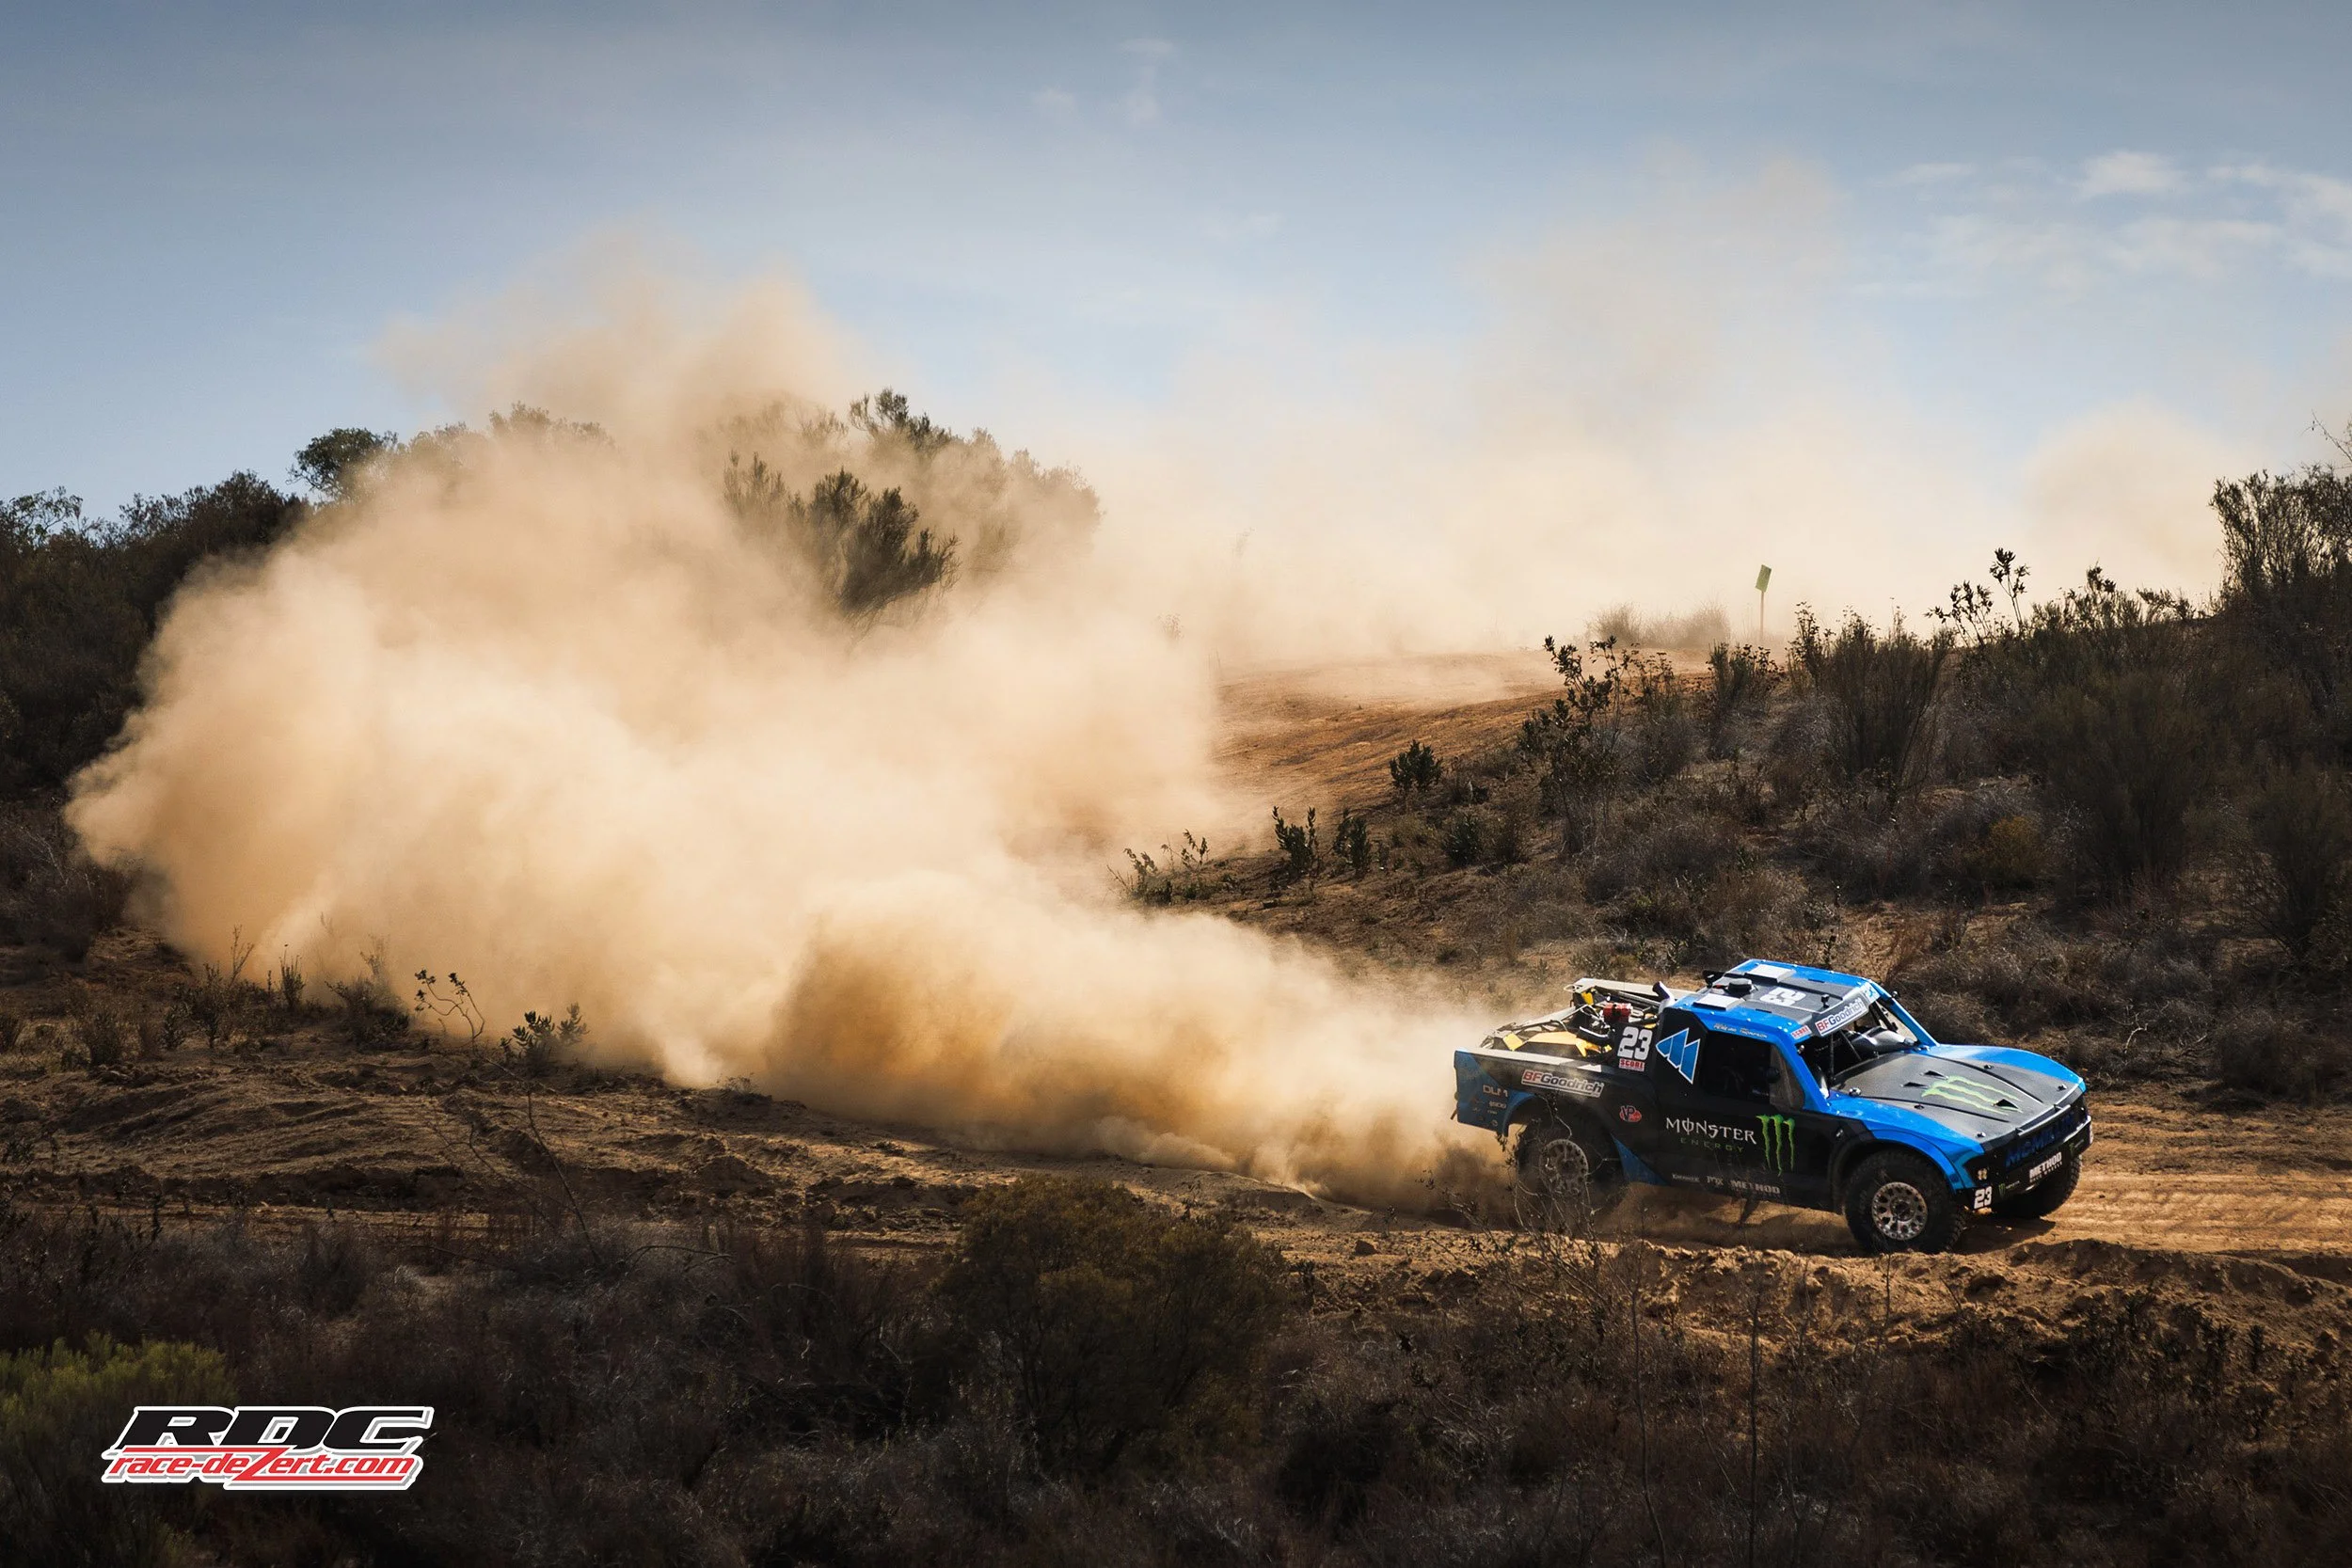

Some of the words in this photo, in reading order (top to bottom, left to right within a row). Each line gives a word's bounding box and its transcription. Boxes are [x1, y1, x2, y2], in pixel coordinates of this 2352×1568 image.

[1816, 997, 1865, 1032] BFGoodrich
[1617, 1026, 1653, 1060] 23
[1523, 1070, 1603, 1094] BFGoodrich
[1665, 1117, 1757, 1145] MONSTER
[1680, 1136, 1745, 1154] ENERGY
[2028, 1151, 2063, 1179] METHOD
[1730, 1179, 1781, 1195] METHOD
[1974, 1185, 1993, 1209] 23
